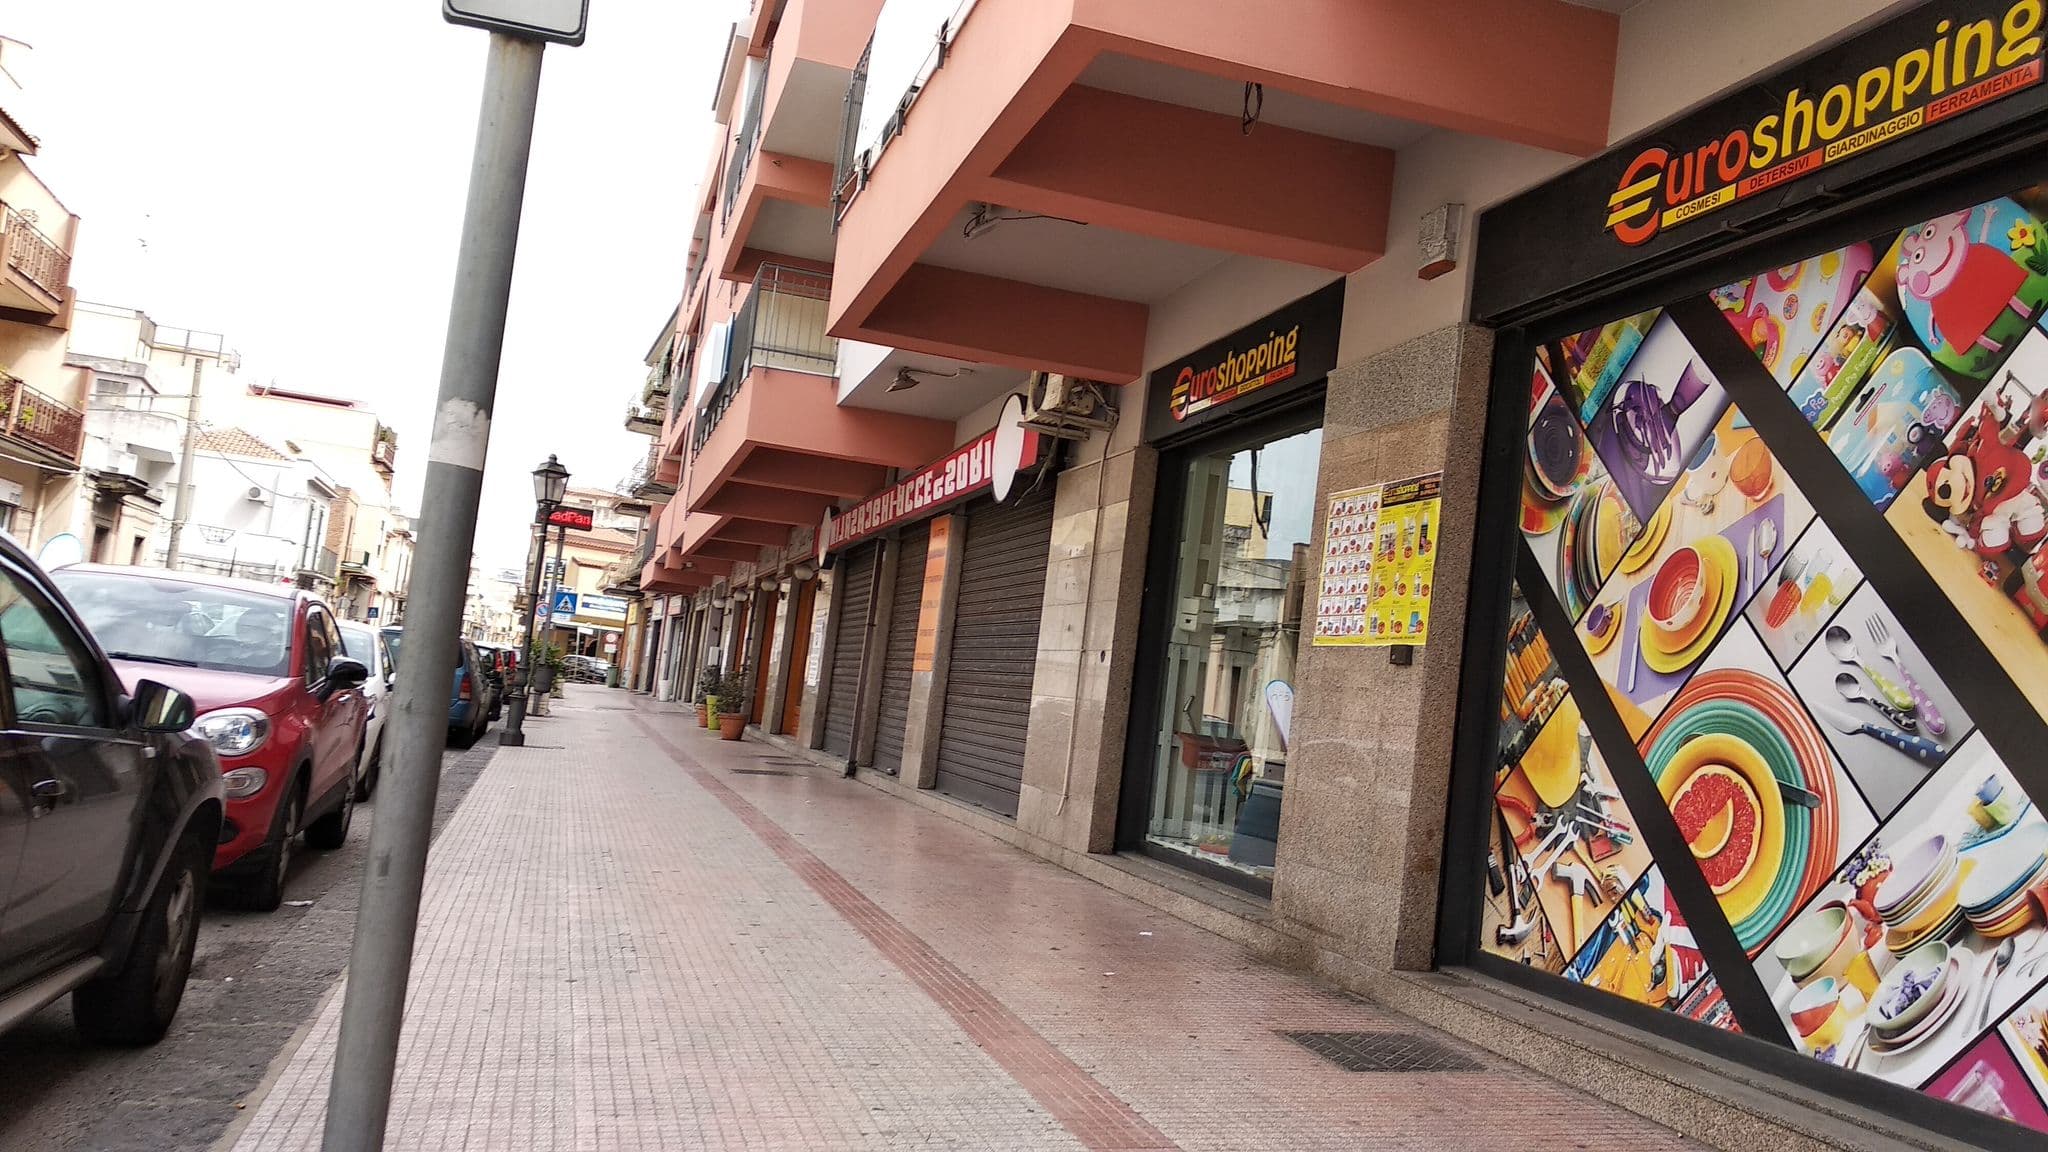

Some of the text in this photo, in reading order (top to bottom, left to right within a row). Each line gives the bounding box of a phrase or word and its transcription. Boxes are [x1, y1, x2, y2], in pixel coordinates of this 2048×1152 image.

[1675, 68, 2034, 219] COSMESI DETERSIVI GIARDINAGGIO FERRAMENTA
